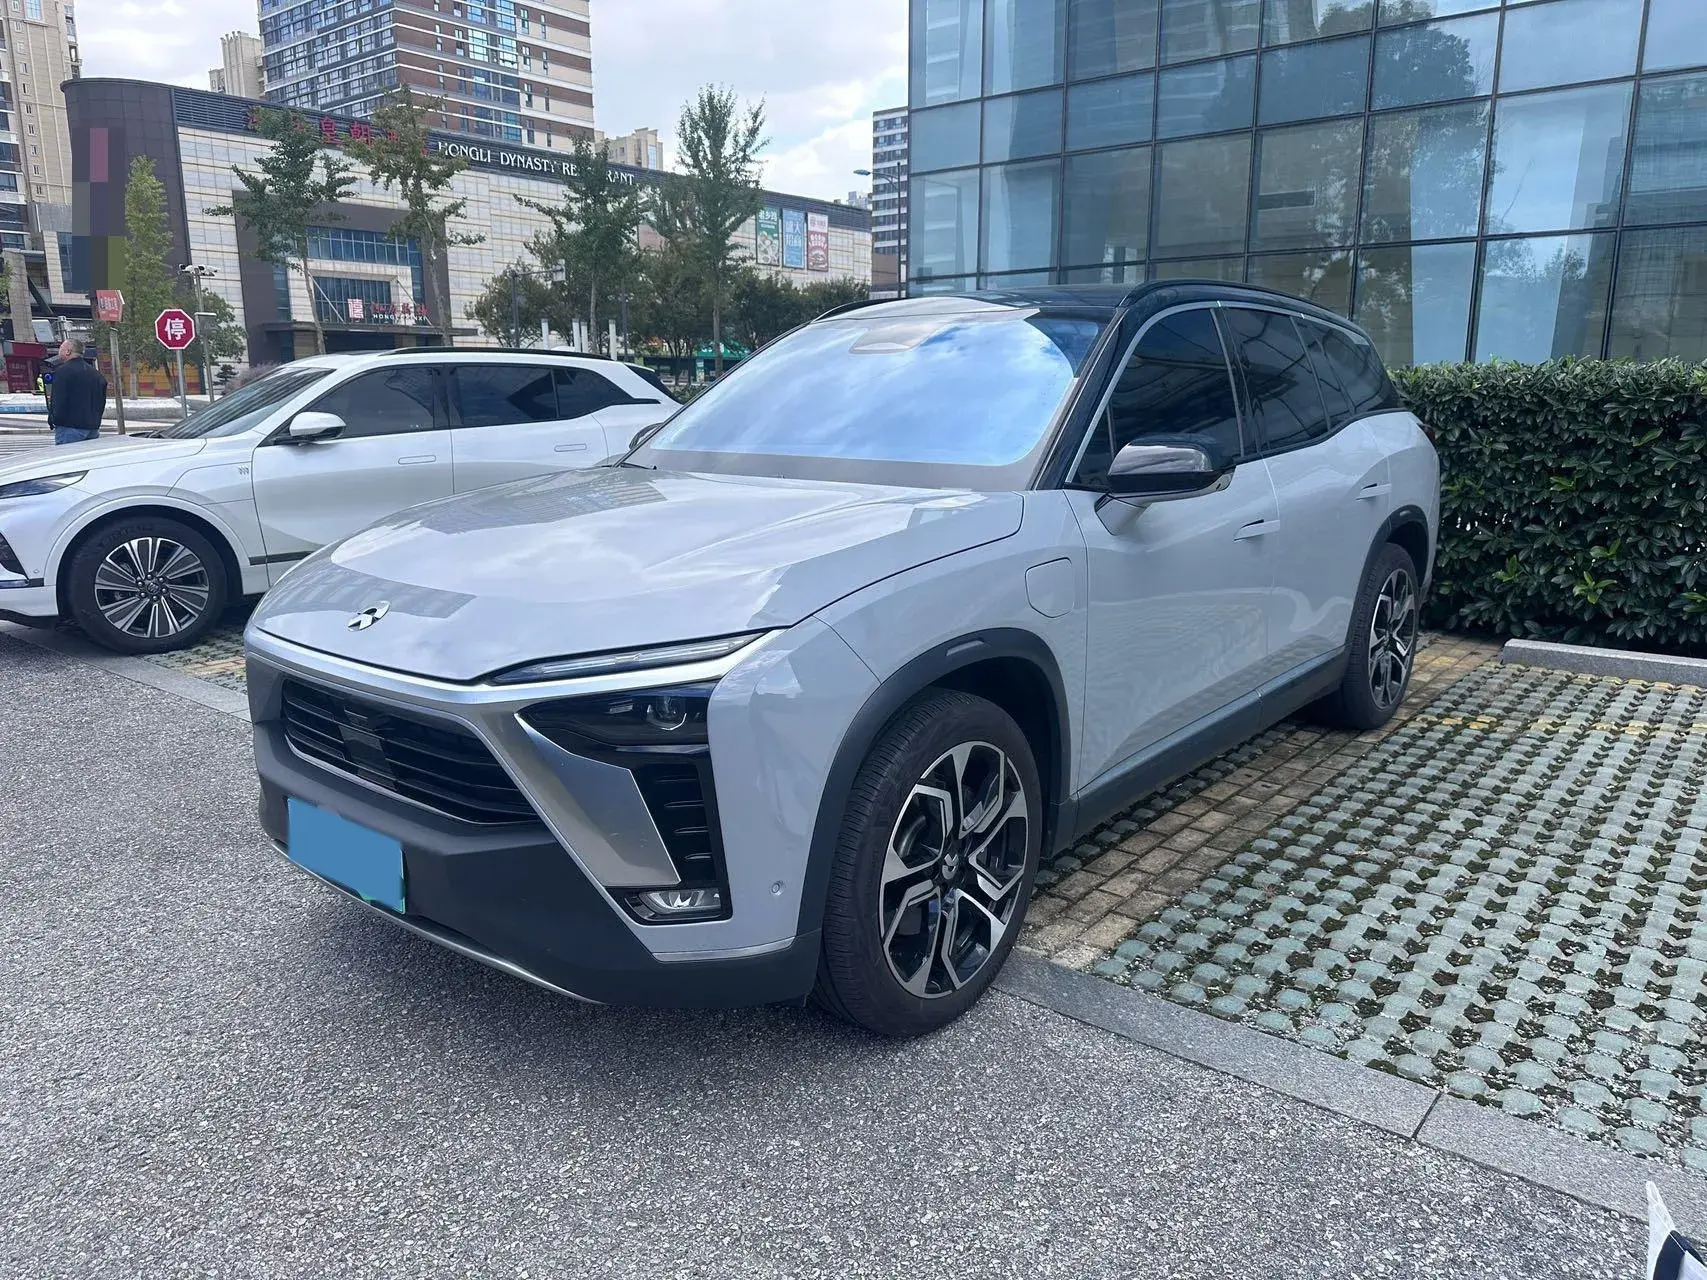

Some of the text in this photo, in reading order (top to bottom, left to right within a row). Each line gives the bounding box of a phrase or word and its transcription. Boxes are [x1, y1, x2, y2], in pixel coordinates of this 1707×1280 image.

[438, 142, 491, 163] HONGLI
[500, 152, 557, 173] DYNASTY
[562, 162, 634, 185] RERANT
[164, 318, 187, 341] 停
